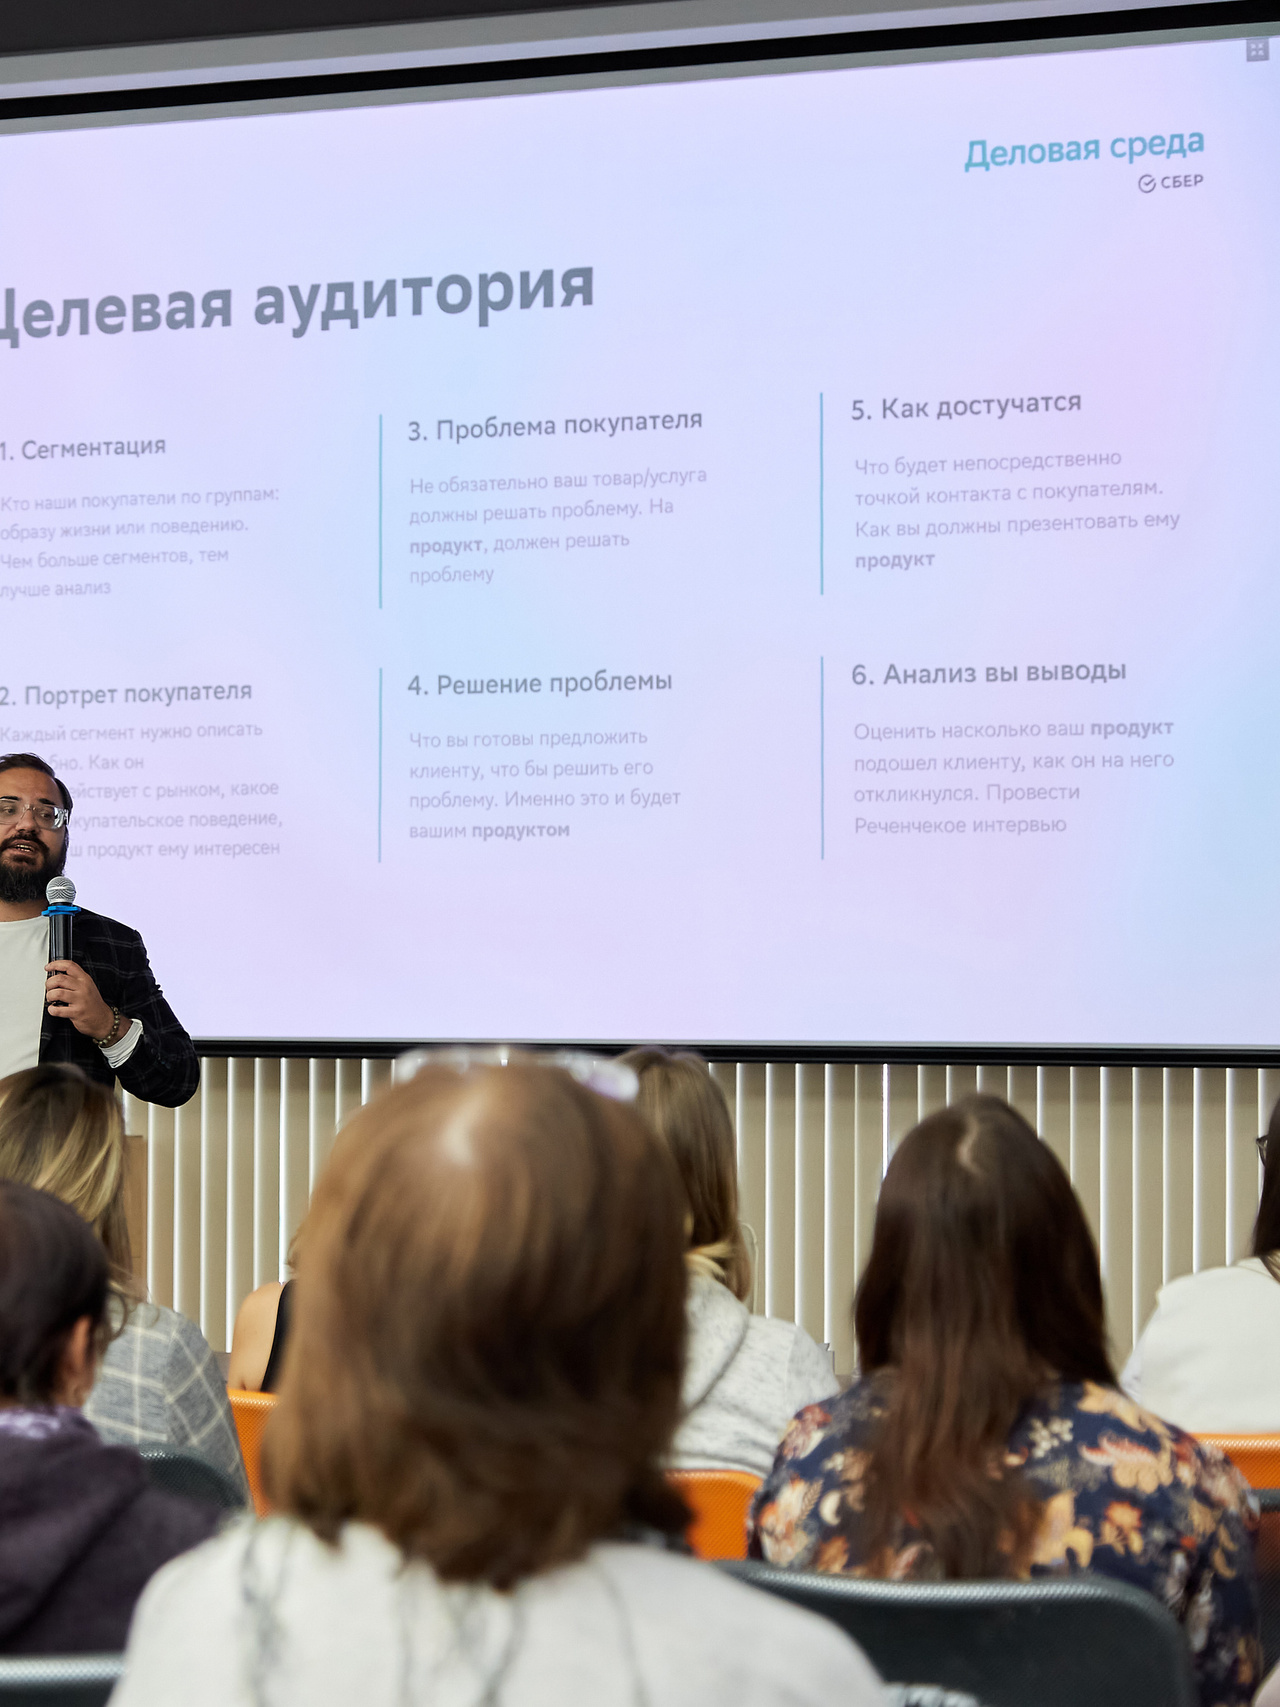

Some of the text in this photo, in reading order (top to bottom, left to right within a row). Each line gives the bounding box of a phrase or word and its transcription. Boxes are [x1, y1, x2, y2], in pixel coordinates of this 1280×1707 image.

[964, 132, 1204, 173] Деловая среда
[1161, 174, 1204, 189] СБЕР
[254, 267, 593, 339] аудитория
[852, 395, 1081, 421] 5. Как достучатся
[408, 413, 702, 444] 3. Проблема покупателя
[0, 439, 166, 461] 1. Сегментация
[855, 452, 1122, 478] Что будет непосредственно
[410, 467, 707, 494] Не обязательно ваш товар/услуга
[0, 488, 279, 512] Кто наши покупатели по группам:
[855, 487, 920, 506] точкой
[926, 488, 1011, 503] контакта
[1017, 487, 1027, 500] с
[409, 498, 674, 526] должны решать проблему. На
[0, 519, 249, 543] образу жизни или поведению.
[856, 514, 1180, 538] Как вы должны презентовать ему
[410, 534, 630, 557] продукт, должен решать
[0, 550, 229, 569] Чем больше сегментов, тем
[855, 554, 935, 572] продукт
[410, 565, 494, 586] проблему
[0, 582, 112, 601] лучше анализ
[407, 669, 672, 697] 4. Решение проблемы
[852, 663, 1126, 685] 6. Анализ вы выводы
[25, 685, 118, 709] Портрет
[125, 684, 252, 707] покупателя
[0, 724, 263, 743] Каждый сегмент нужно описать
[409, 731, 648, 749] Что вы готовы предложить
[854, 722, 1174, 742] Оценить насколько ваш продукт
[89, 754, 119, 770] Как
[124, 757, 144, 770] он
[410, 759, 654, 781] клиенту, что бы решить его
[854, 754, 1175, 774] подошел клиенту, как он на него
[142, 786, 151, 798] с
[156, 784, 225, 801] рынком,
[230, 783, 279, 796] какое
[409, 787, 681, 811] проблему. Именно это и будет
[854, 783, 1080, 805] откликнулся. Провести
[73, 815, 184, 831] купательское
[409, 825, 570, 842] вашим продуктом
[855, 817, 1067, 836] Реченчекое интервью
[88, 844, 153, 860] продукт
[158, 844, 189, 860] ему
[194, 842, 280, 859] интересен
